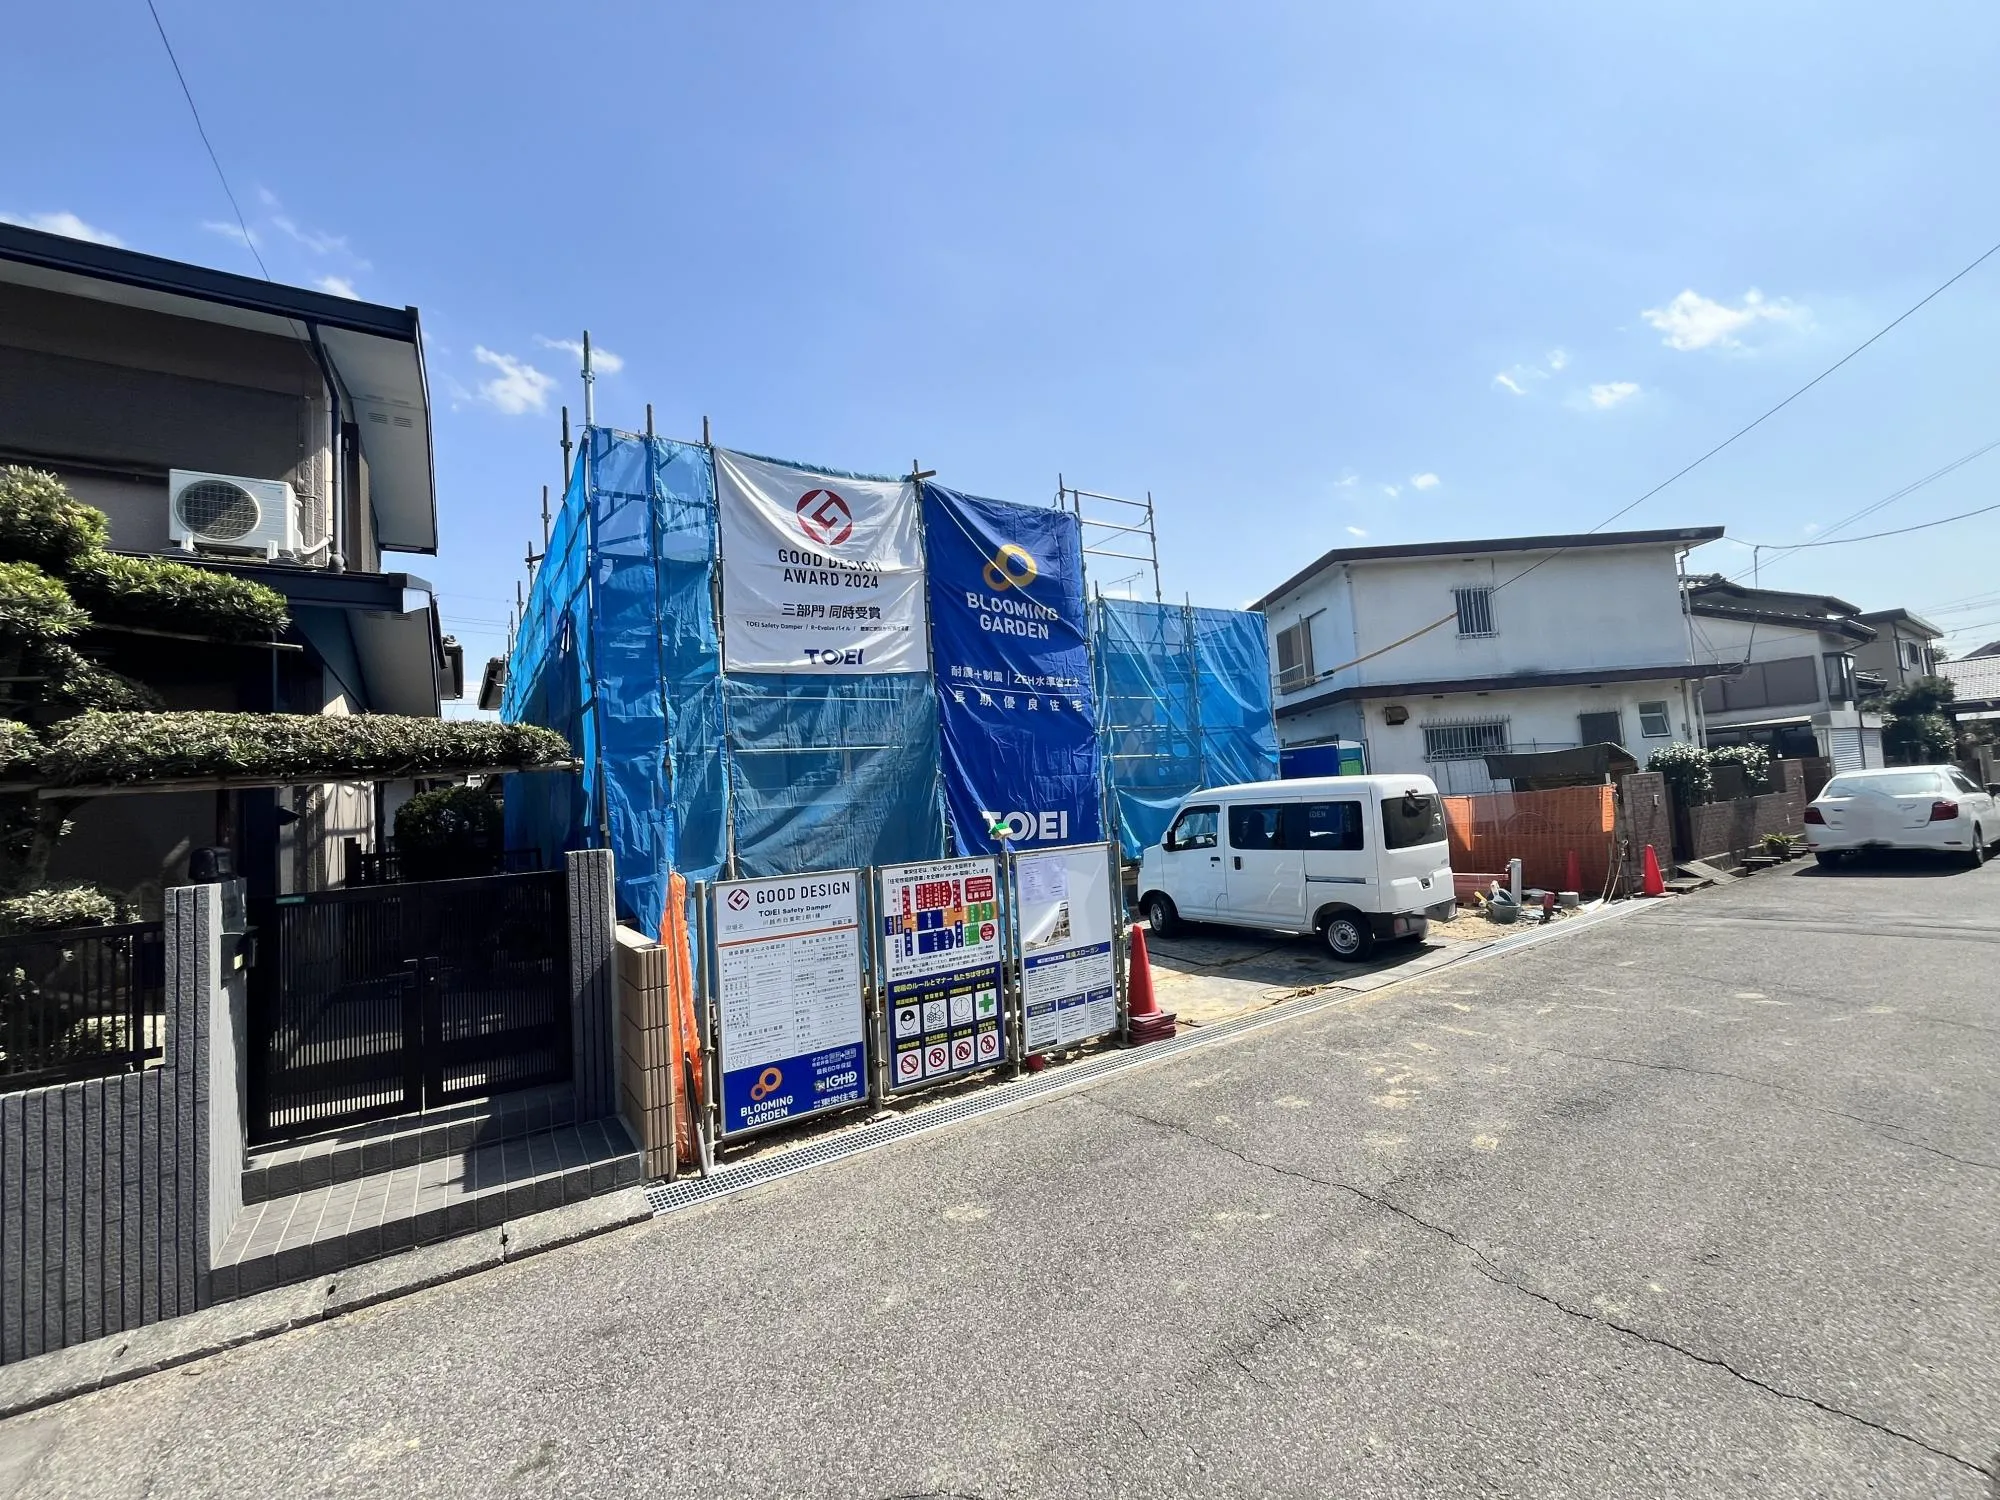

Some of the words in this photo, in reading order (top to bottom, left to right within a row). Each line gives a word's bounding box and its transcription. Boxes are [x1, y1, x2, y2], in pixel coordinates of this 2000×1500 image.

[778, 549, 822, 567] GOOD
[783, 569, 839, 586] AWARD
[845, 573, 878, 588] 2024
[781, 602, 824, 618] 三部門
[829, 605, 881, 620] 同時受賞
[966, 592, 1058, 621] BLOOMING
[761, 622, 779, 630] Safety
[980, 614, 1049, 640] GARDEN
[804, 648, 864, 665] TOEI
[954, 690, 1083, 712] 長期優良住宅
[756, 888, 795, 905] GOOD
[801, 881, 850, 899] DESIGN
[758, 908, 780, 917] TOEI
[782, 907, 804, 916] Safety
[826, 1071, 857, 1089] IGHD
[740, 1095, 793, 1117] BLOOMING
[746, 1106, 788, 1126] GARDEN
